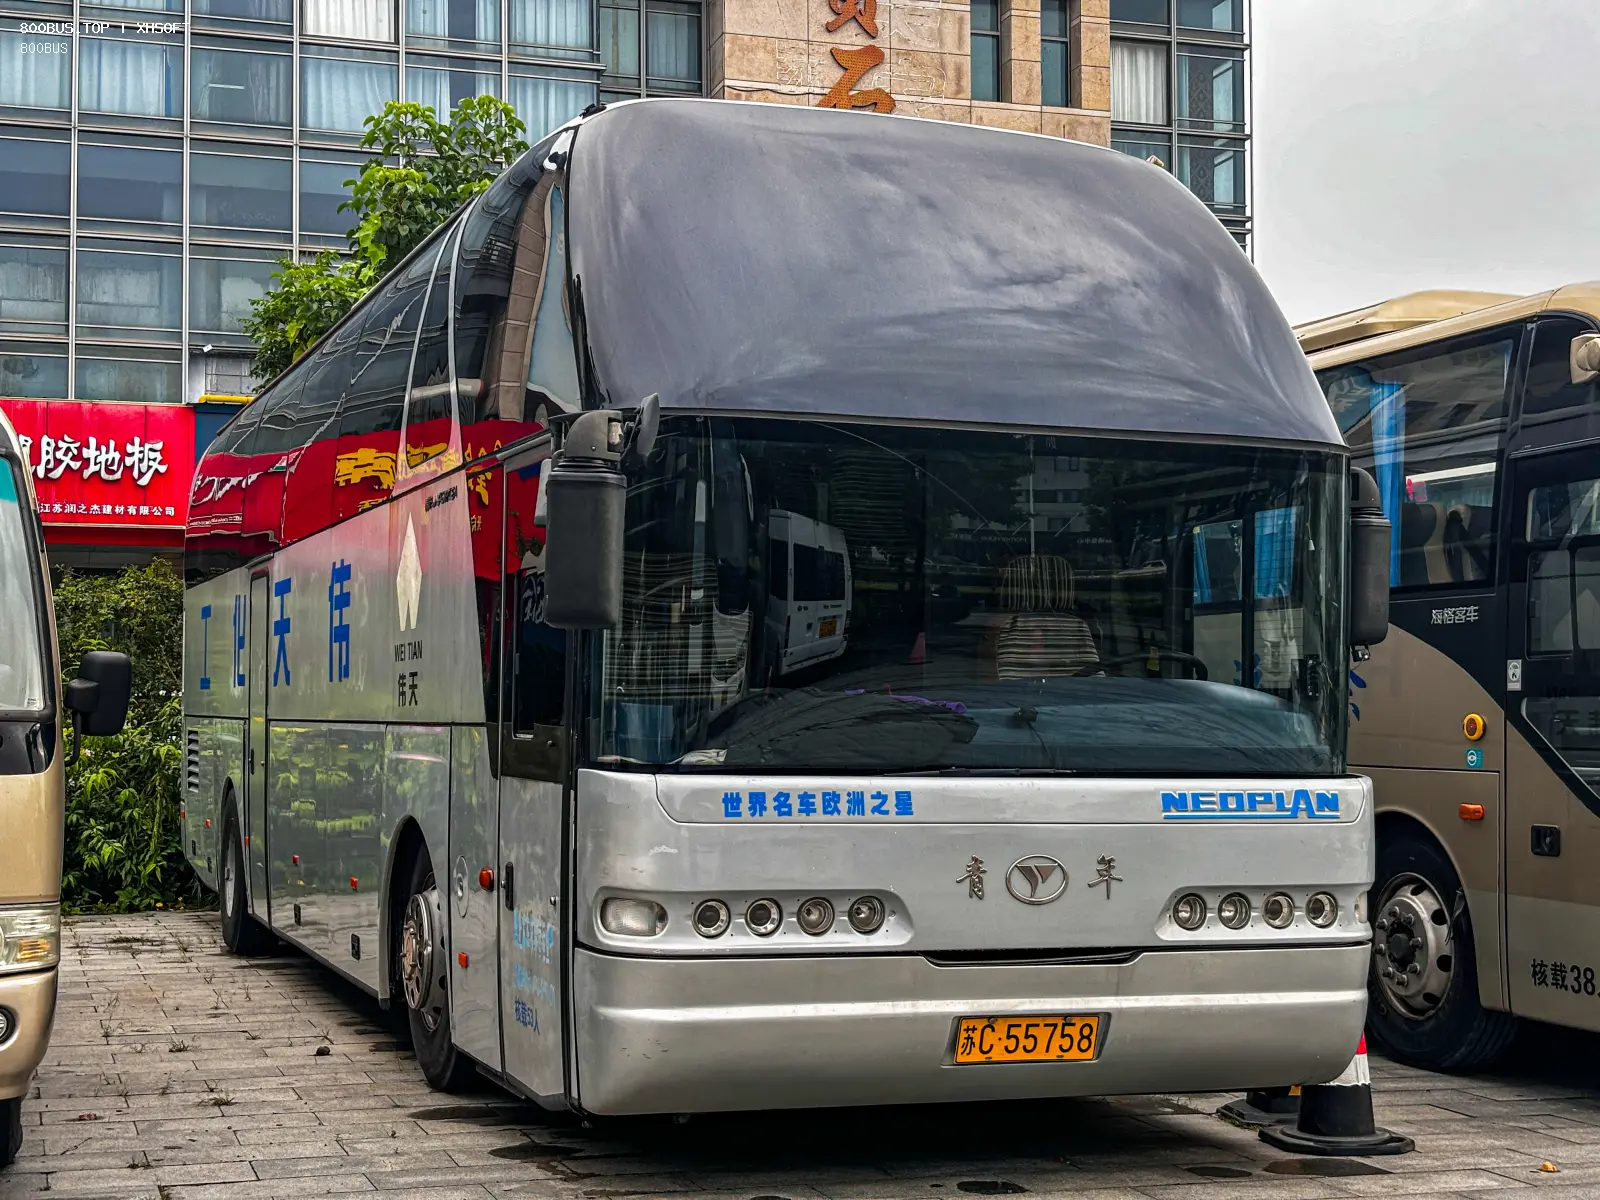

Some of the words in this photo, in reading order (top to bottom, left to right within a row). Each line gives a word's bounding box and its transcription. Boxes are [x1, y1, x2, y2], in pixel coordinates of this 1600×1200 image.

[1431, 605, 1479, 625] 海格客车
[394, 643, 406, 662] WEI
[407, 640, 423, 660] TIAN
[398, 671, 419, 707] 伟天
[721, 790, 914, 818] 世界名车欧洲之星
[1160, 788, 1341, 819] NEOPLAN
[1530, 958, 1600, 998] 核载38
